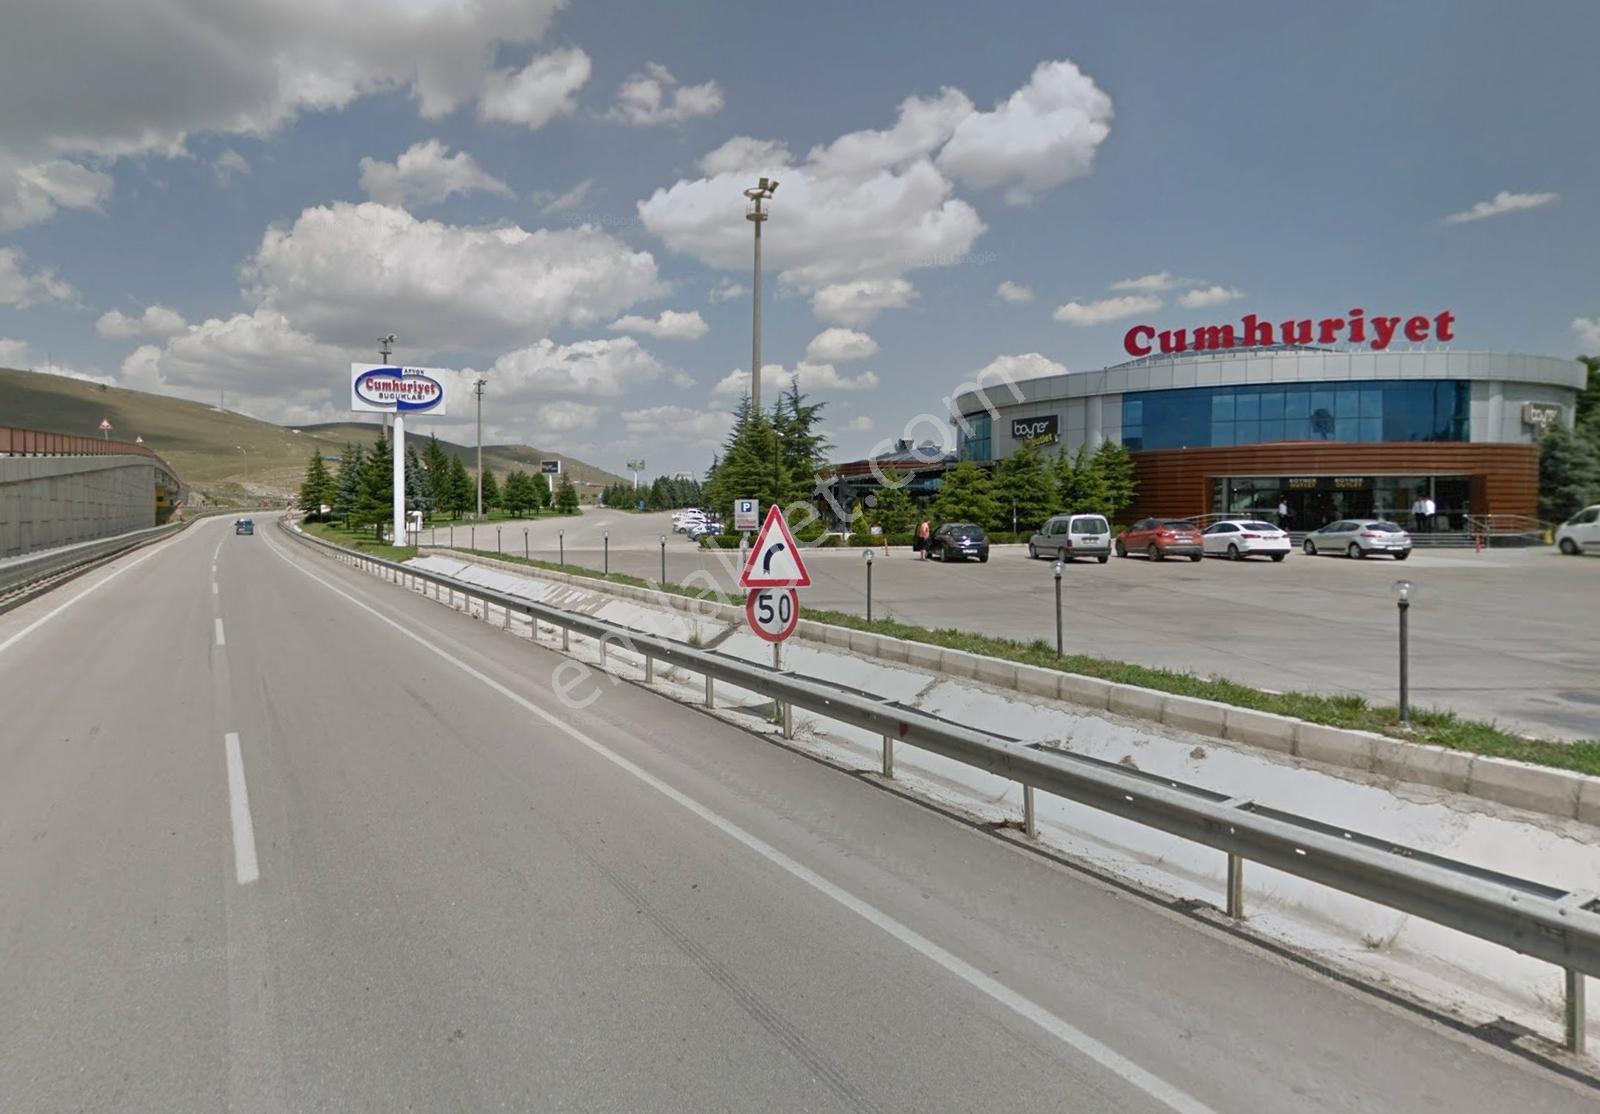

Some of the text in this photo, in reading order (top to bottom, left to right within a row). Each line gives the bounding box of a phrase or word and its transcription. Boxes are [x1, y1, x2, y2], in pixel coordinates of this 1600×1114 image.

[1123, 308, 1456, 357] Cumhuriyet
[366, 377, 435, 396] Cumhuriyet
[1014, 421, 1049, 439] boyner
[758, 594, 791, 625] 50
